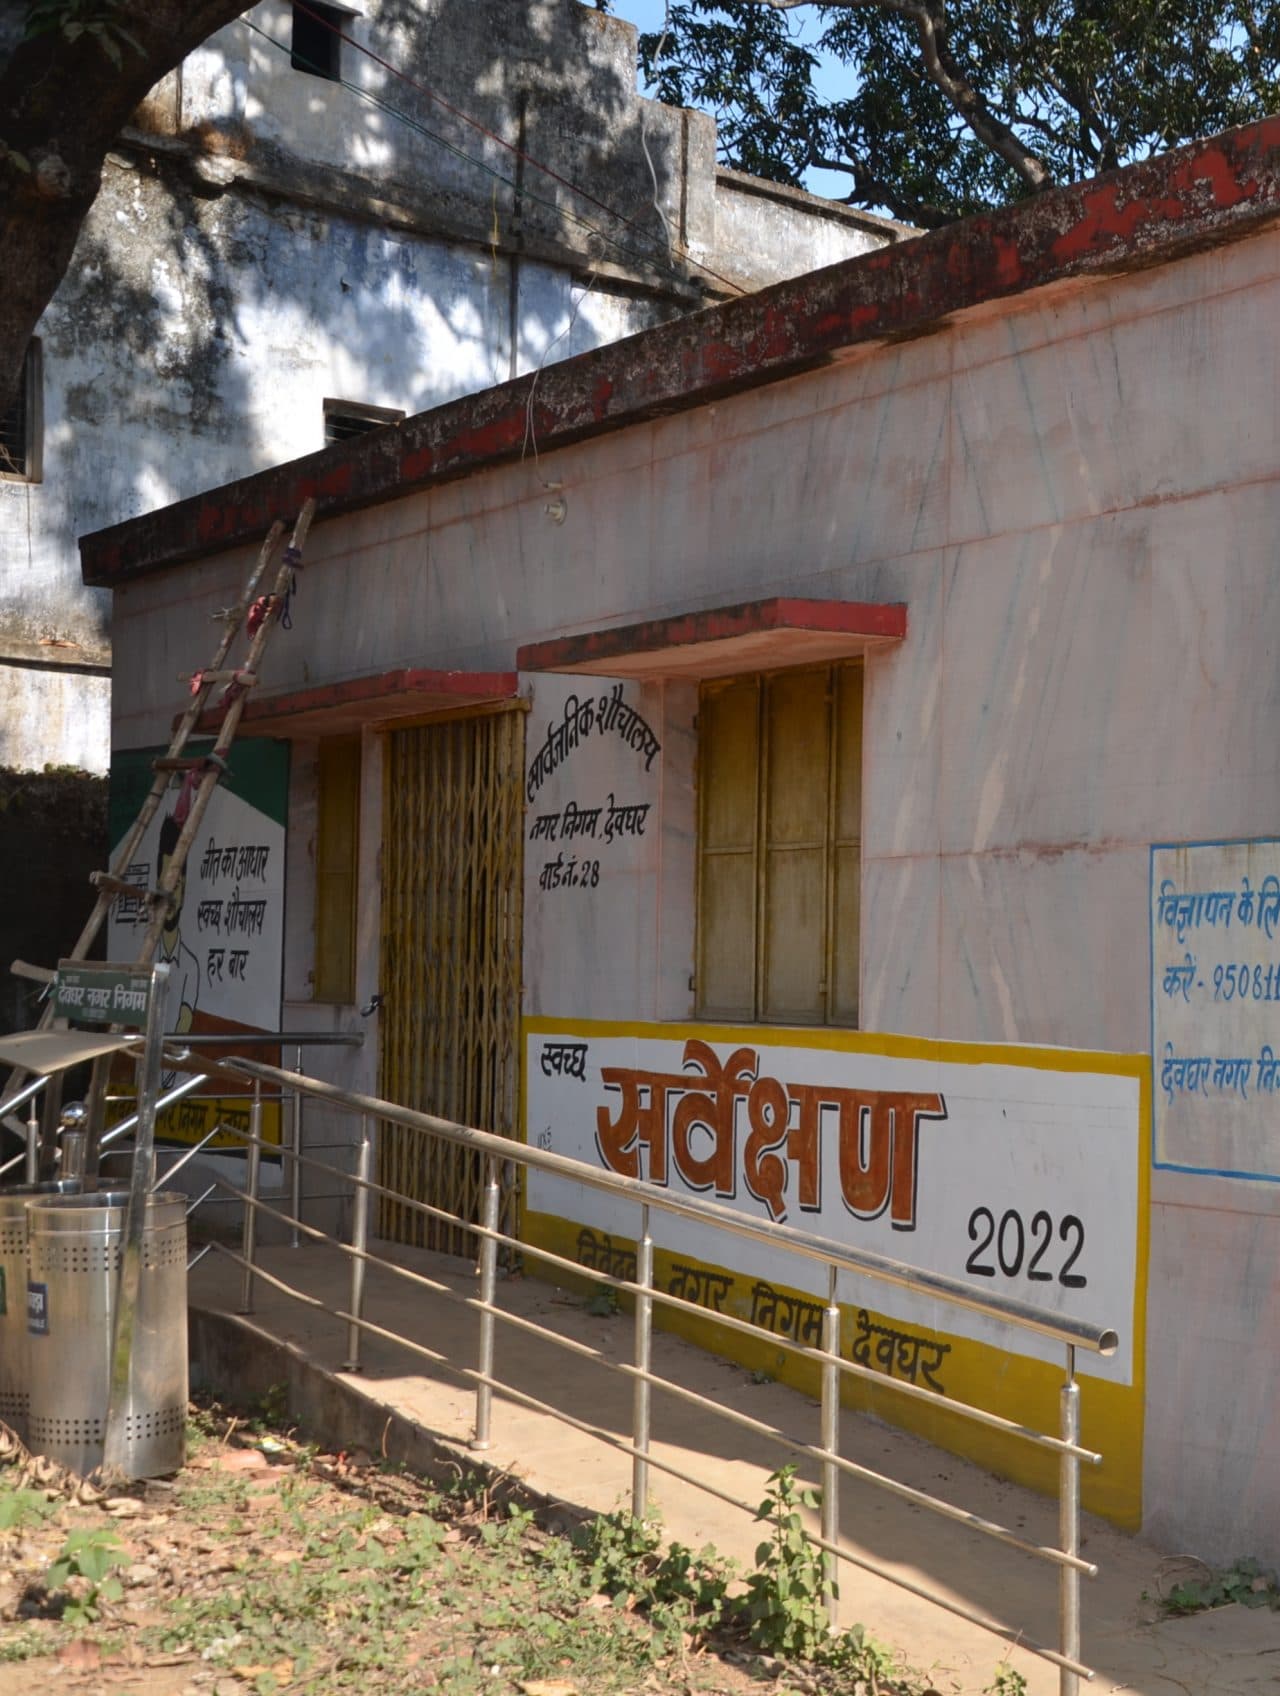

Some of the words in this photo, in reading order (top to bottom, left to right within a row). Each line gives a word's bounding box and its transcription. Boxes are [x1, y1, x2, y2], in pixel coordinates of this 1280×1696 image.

[596, 683, 662, 772] शौचालय
[529, 814, 560, 841] नगर
[604, 793, 650, 844] देवघर
[200, 837, 223, 886] जीत
[221, 846, 238, 878] का
[236, 845, 270, 883] आधार
[579, 860, 600, 888] 28
[1158, 879, 1236, 944] विज्ञापन
[1238, 876, 1254, 926] के
[207, 948, 226, 988] हर
[112, 983, 148, 1013] निगम
[541, 1043, 589, 1083] स्वच्छ
[1161, 1041, 1211, 1106] देवघर
[1212, 1058, 1252, 1100] नगर
[595, 1038, 948, 1232] सर्वेक्षण
[965, 1205, 1088, 1288] 2022
[852, 1308, 952, 1394] देवघर
